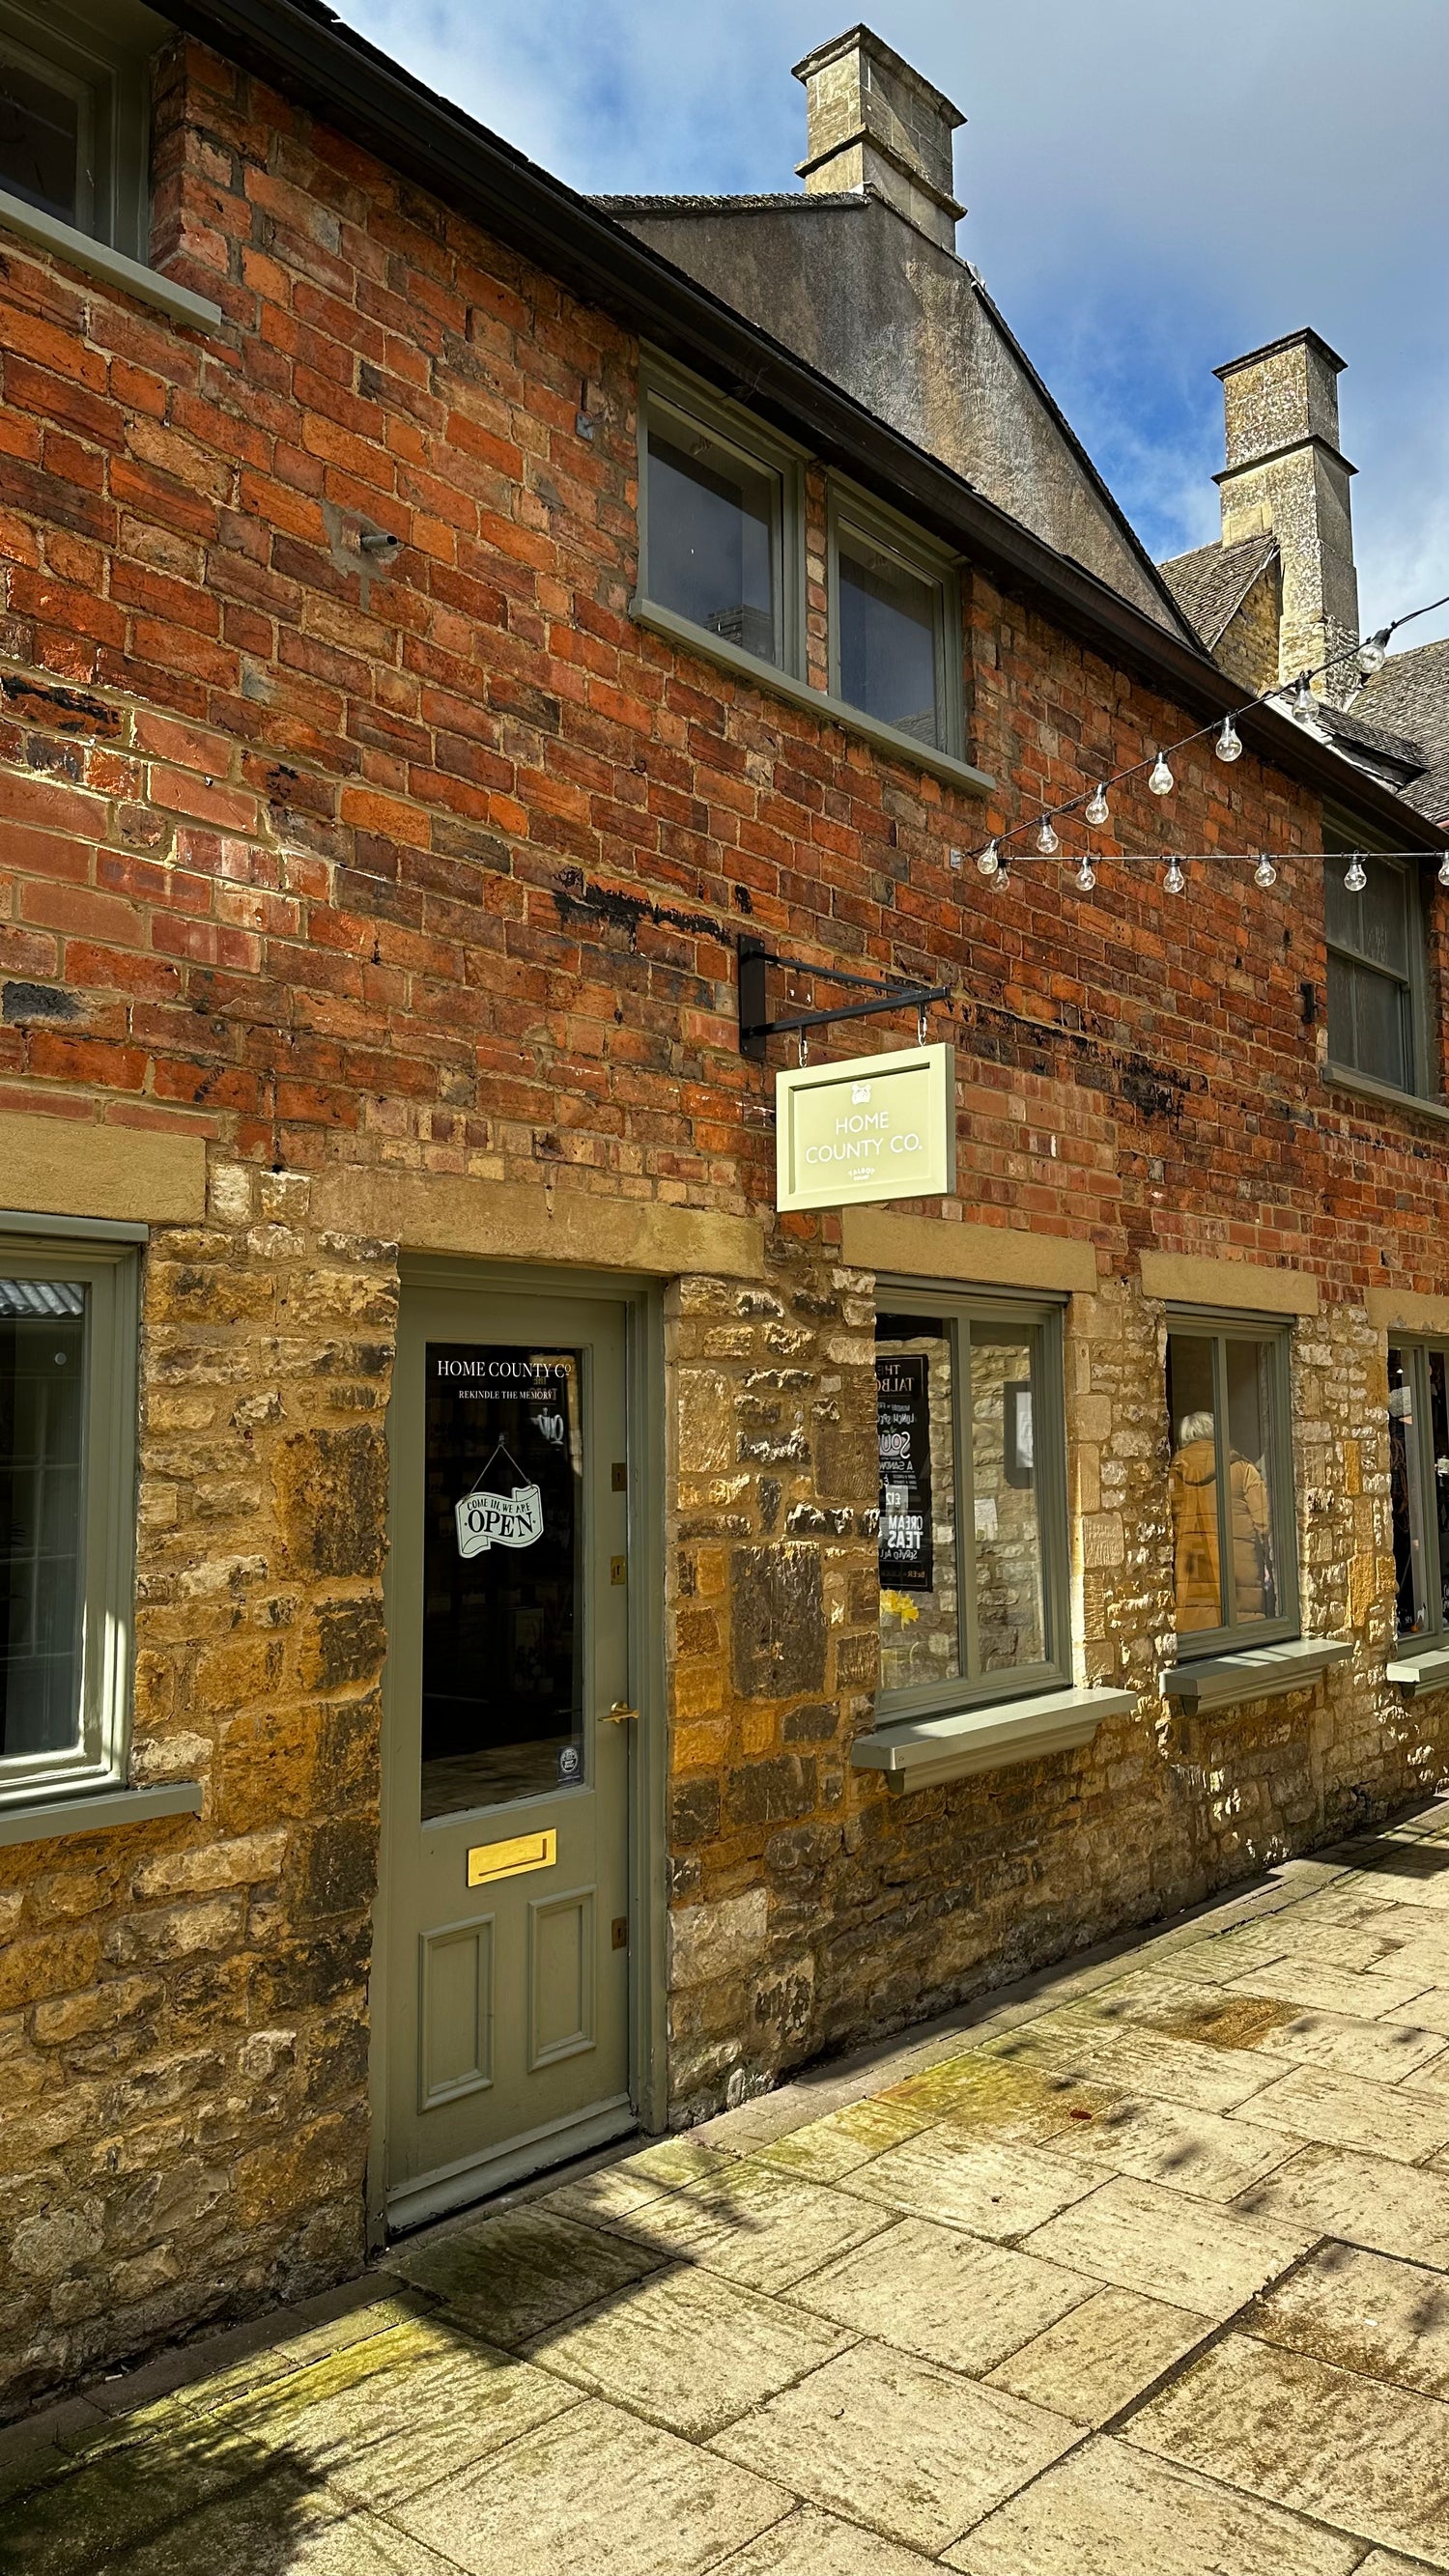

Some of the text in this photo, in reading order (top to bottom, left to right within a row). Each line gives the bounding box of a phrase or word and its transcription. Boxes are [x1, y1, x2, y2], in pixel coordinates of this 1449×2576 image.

[836, 1112, 889, 1135] HOME
[806, 1133, 923, 1164] COUNTY CO.
[438, 1360, 485, 1376] HOME
[489, 1362, 550, 1378] COUNTY
[459, 1390, 499, 1400] REKINDLE
[501, 1391, 518, 1400] THE
[520, 1391, 553, 1400] MEMORY
[468, 1499, 488, 1511] COME
[502, 1503, 514, 1514] WE
[516, 1502, 530, 1514] ARE
[468, 1509, 533, 1538] OPEN
